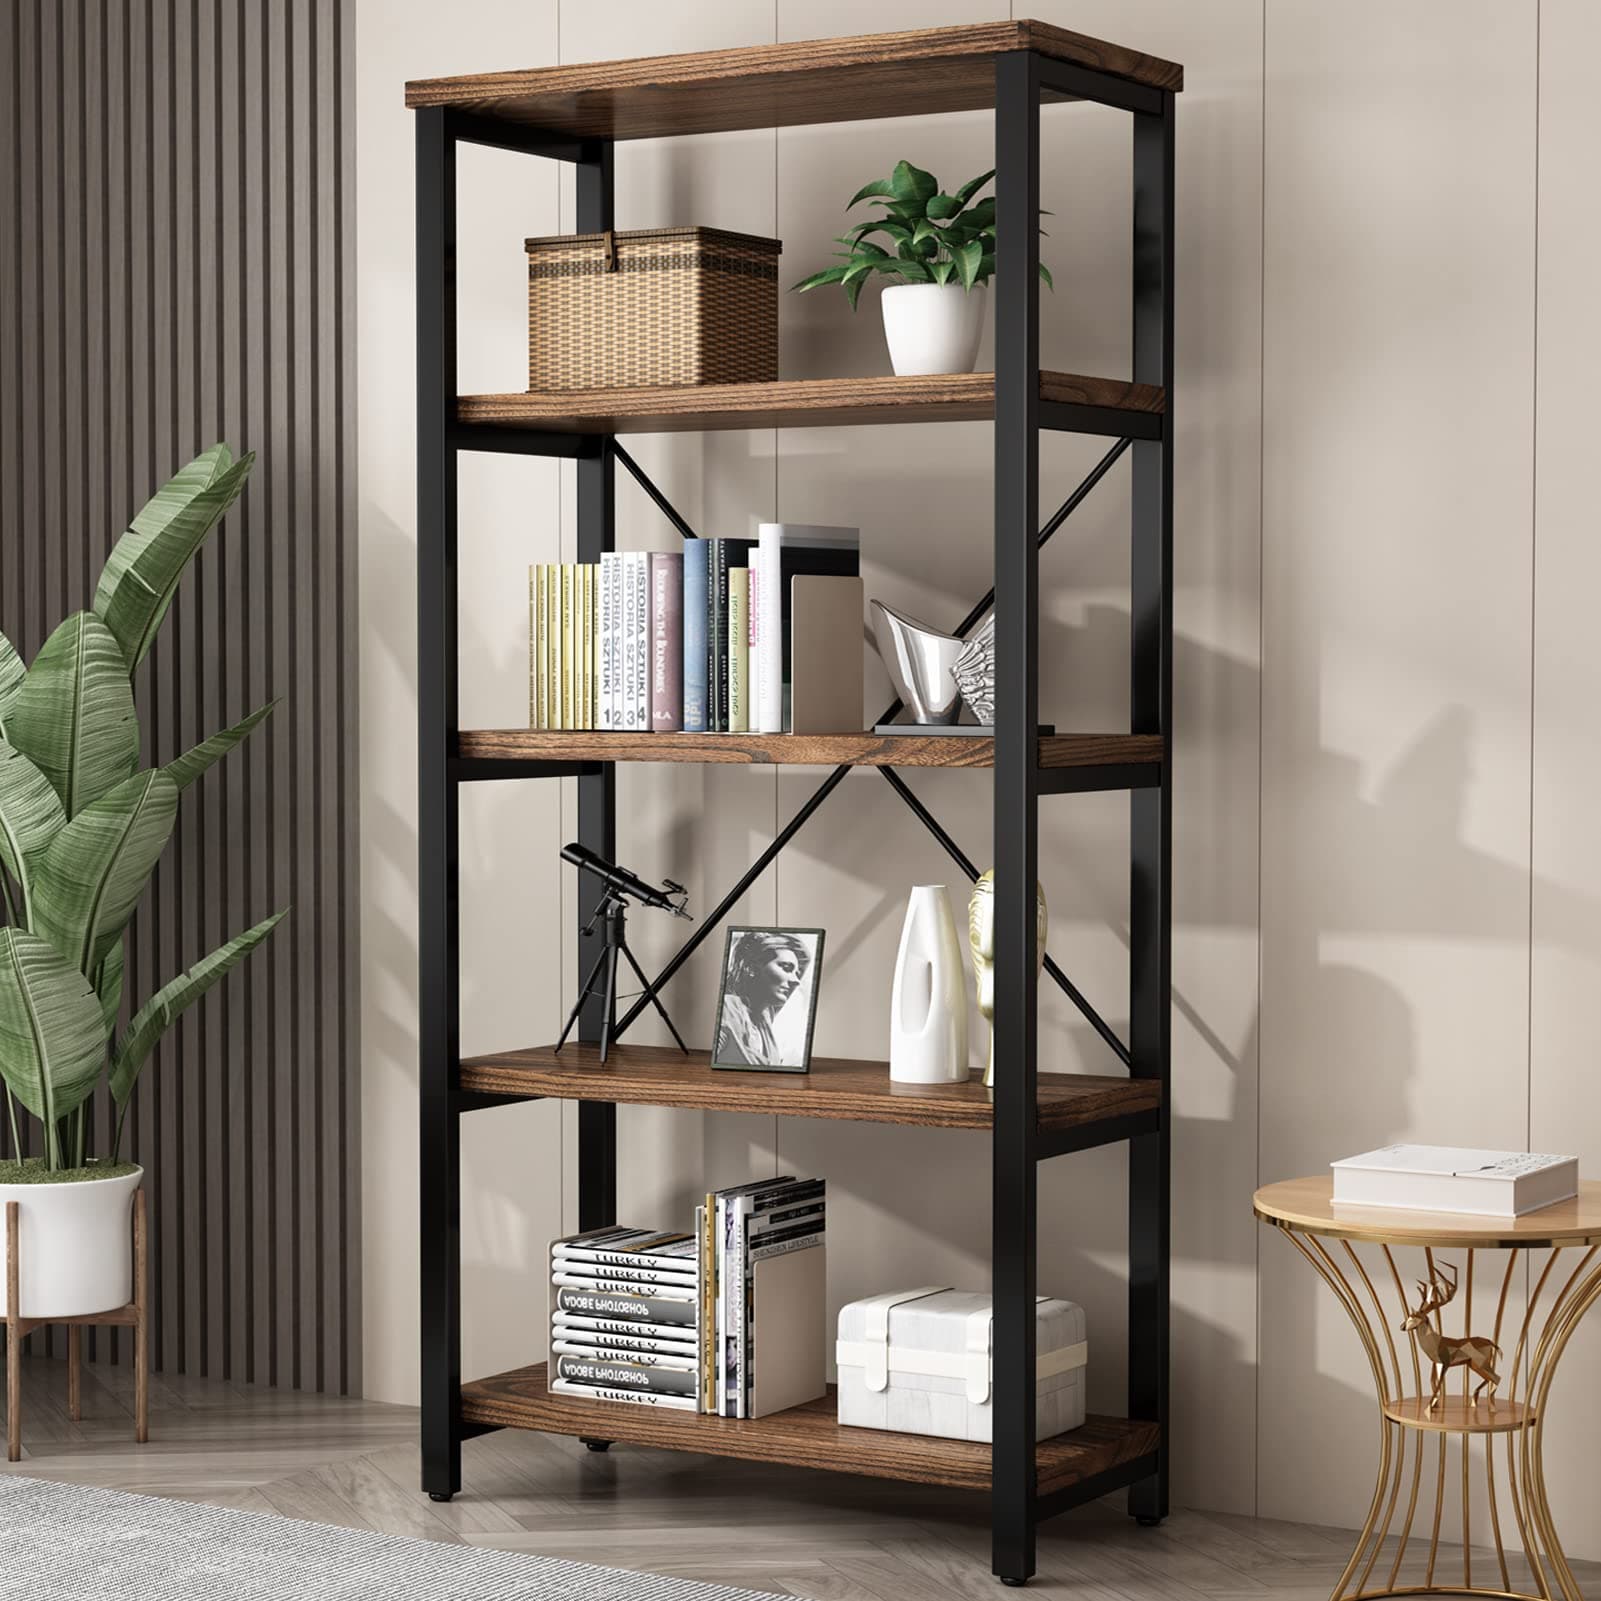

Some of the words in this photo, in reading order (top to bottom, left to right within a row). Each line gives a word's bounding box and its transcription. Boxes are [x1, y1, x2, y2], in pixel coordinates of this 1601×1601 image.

[602, 558, 611, 633] HISTORIA
[613, 556, 621, 631] HISTORIA
[626, 563, 635, 639] HISTORIA
[638, 560, 646, 635] HISTORIA
[602, 637, 611, 695] SZTUKI
[613, 635, 621, 694] SZTUKI
[638, 639, 646, 698] SZTUKI
[626, 643, 635, 702] SZTUKI
[603, 709, 610, 724] 1
[613, 711, 622, 726] 2
[626, 711, 635, 726] 3
[637, 706, 646, 723] 4
[594, 1253, 657, 1267] TURKEY
[594, 1267, 657, 1281] TURKEY
[594, 1281, 657, 1295] TURKEY
[594, 1321, 657, 1336] TURKEY
[594, 1336, 657, 1350] TURKEY
[594, 1350, 657, 1364] TURKEY
[594, 1390, 657, 1404] TURKEY
